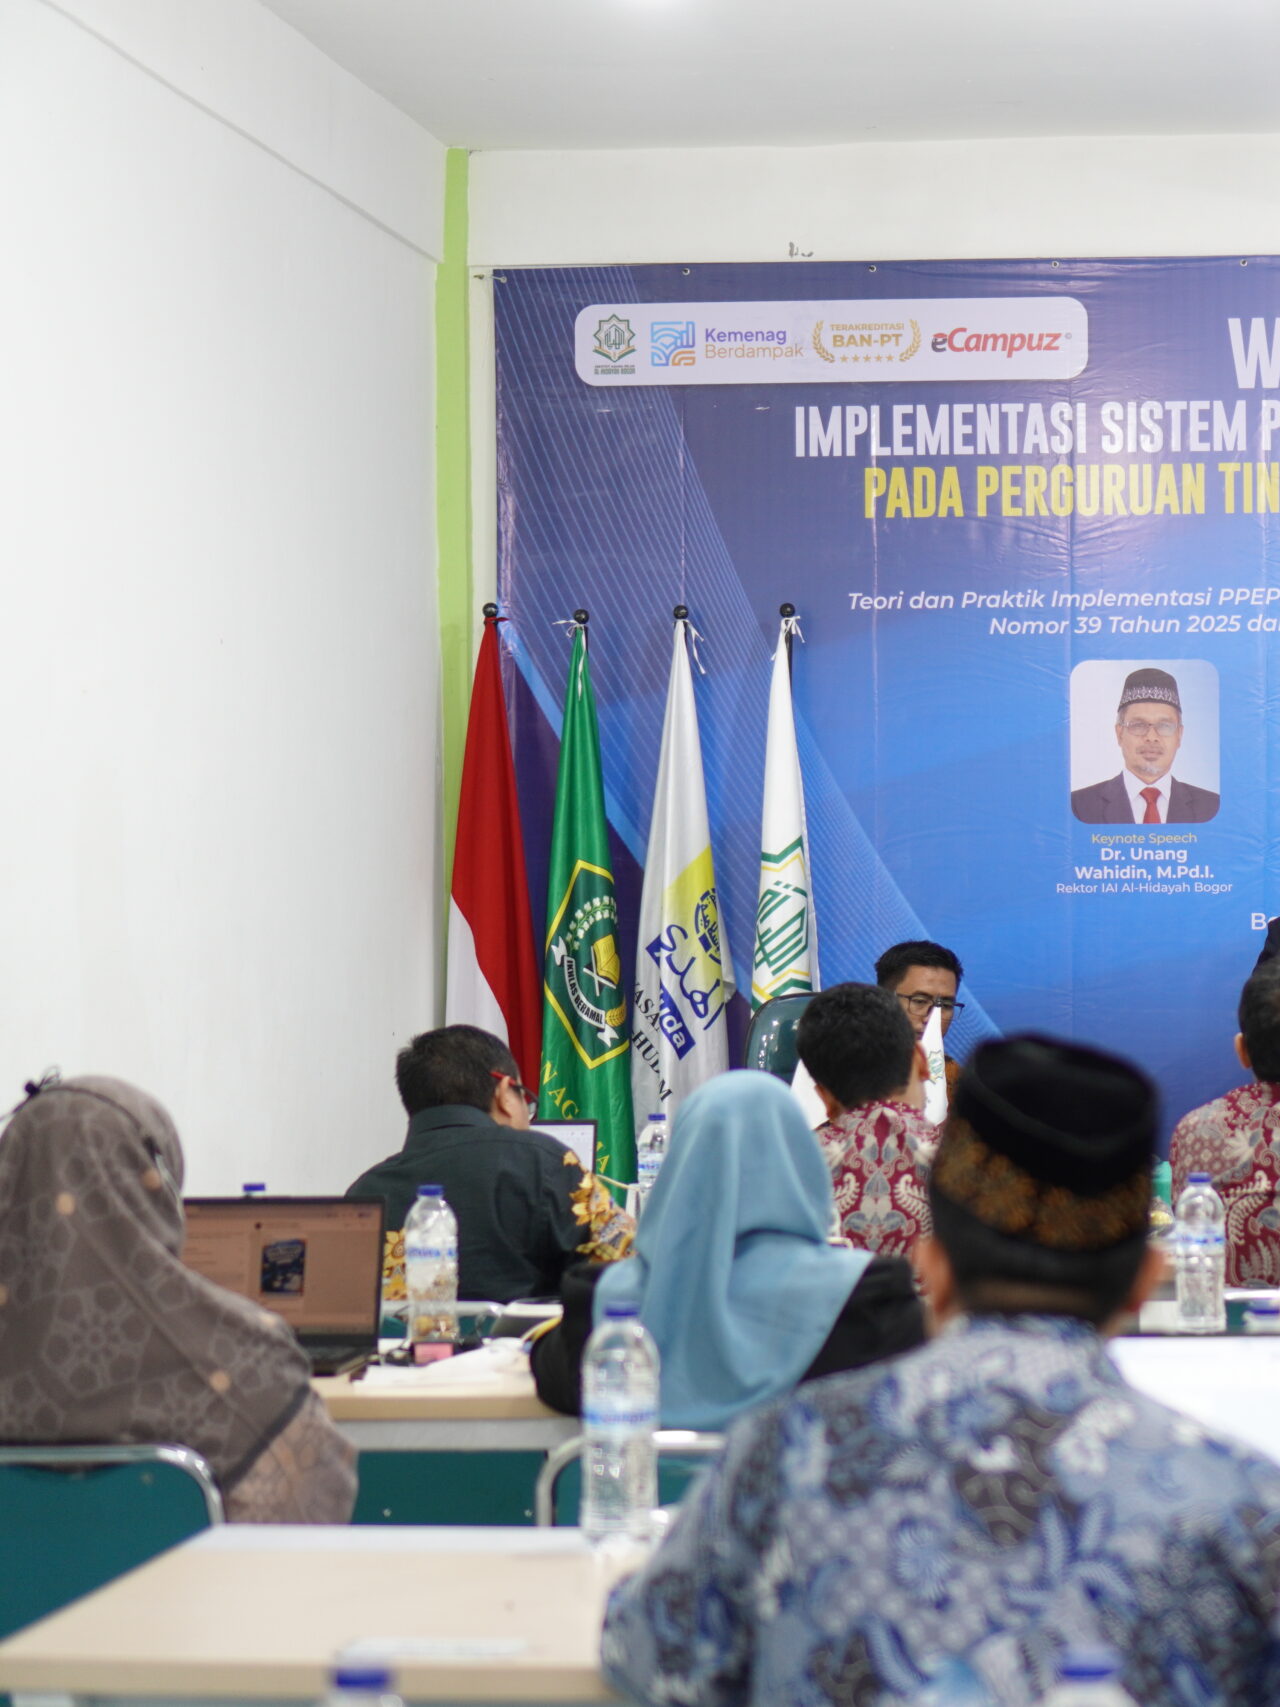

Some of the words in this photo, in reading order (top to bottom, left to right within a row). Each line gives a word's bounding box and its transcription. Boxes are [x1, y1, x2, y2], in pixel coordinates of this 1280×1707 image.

[830, 322, 905, 332] TERAKREDITASI
[705, 328, 786, 345] Kemenag
[833, 333, 903, 349] BAN-PT
[705, 344, 804, 360] Berdampak
[795, 400, 1087, 457] IMPLEMENTASI
[1101, 399, 1247, 453] SISTEM
[863, 466, 965, 518] PADA
[977, 463, 1207, 517] PERGURUAN
[849, 591, 904, 609] Teori
[909, 591, 954, 609] dan
[961, 589, 1045, 608] Praktik
[1051, 588, 1212, 611] Implementasi
[989, 618, 1070, 635] Nomor
[1074, 617, 1102, 634] 39
[1108, 616, 1180, 633] Tahun
[1186, 615, 1241, 633] 2025
[1091, 833, 1145, 847] Keynote
[1148, 832, 1197, 846] Speech
[1101, 848, 1125, 861] Dr.
[1130, 847, 1188, 863] Unang
[1075, 866, 1152, 881] Wahidin,
[1156, 865, 1214, 879] M.Pd.I.
[1056, 883, 1098, 894] Rektor
[1121, 882, 1191, 895] Al-Hidayah
[1194, 882, 1233, 895] Bogor
[567, 960, 579, 997] IKHLAS
